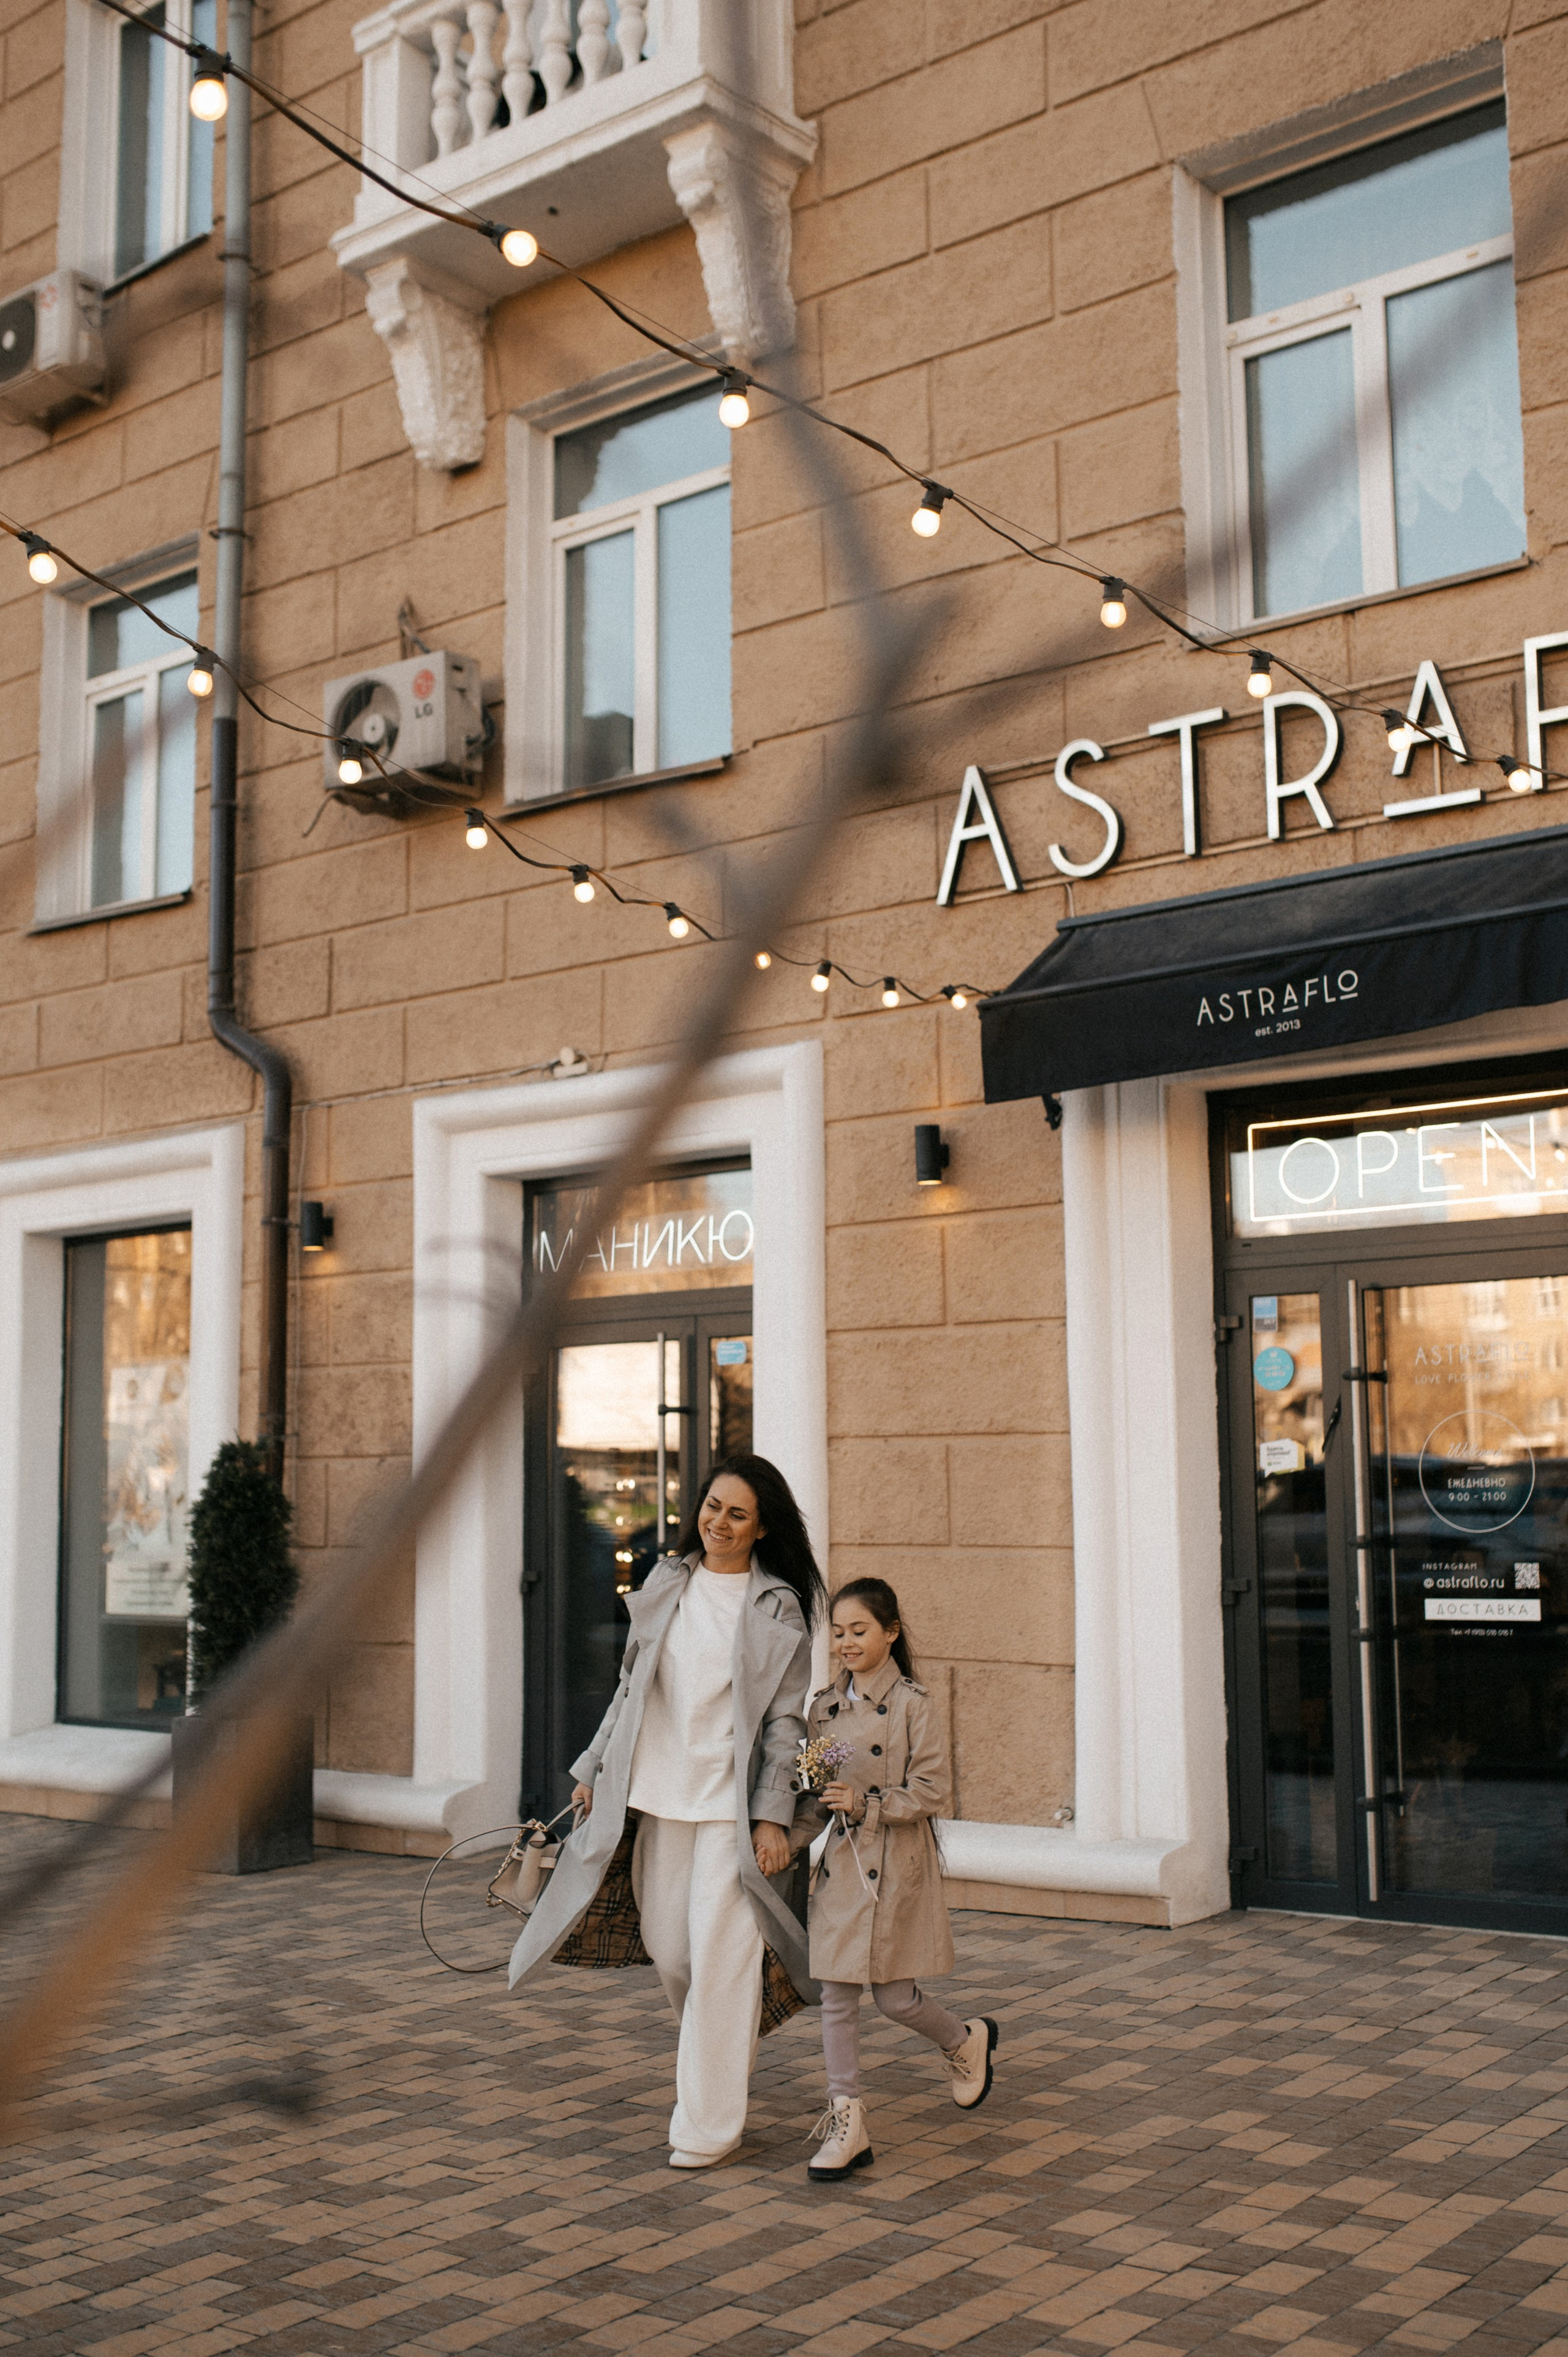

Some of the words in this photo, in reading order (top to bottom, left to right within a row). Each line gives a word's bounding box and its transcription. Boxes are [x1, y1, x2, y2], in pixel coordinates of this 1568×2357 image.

[414, 703, 433, 719] LG
[1197, 970, 1359, 1026] ASTRAFLO
[1255, 1026, 1273, 1037] est.
[1276, 1019, 1301, 1031] 2013
[1278, 1115, 1537, 1204] OPEN
[1414, 1341, 1529, 1366] ASTRAFLO
[1414, 1374, 1441, 1385] LOVE
[1447, 1477, 1506, 1489] ЕЖЕДНЕВНО
[1437, 1603, 1529, 1616] ДОСТАВКА
